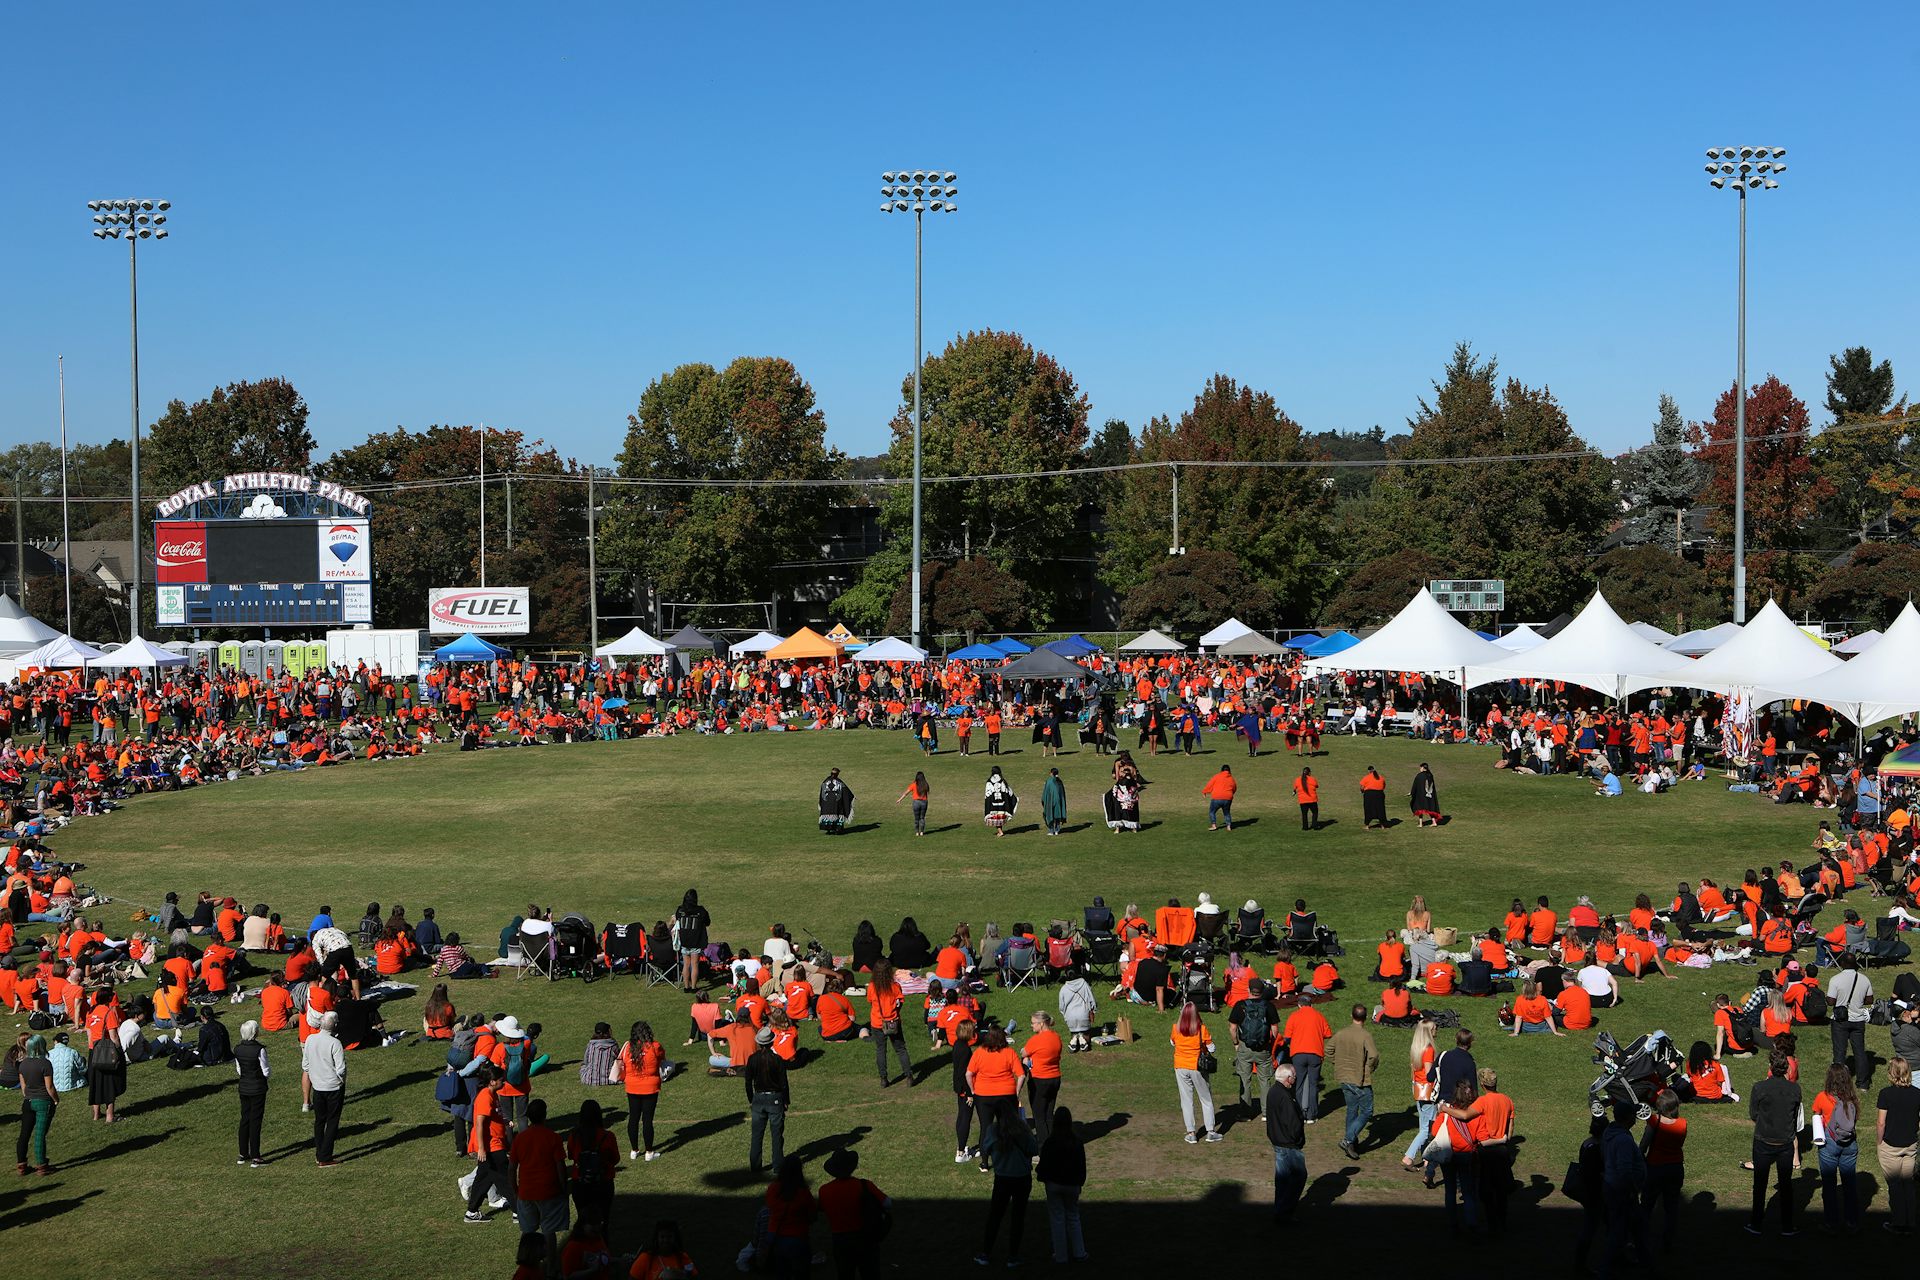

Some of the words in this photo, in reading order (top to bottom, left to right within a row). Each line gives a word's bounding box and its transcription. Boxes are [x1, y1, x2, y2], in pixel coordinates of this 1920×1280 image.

[157, 481, 217, 518] ROYAL
[222, 472, 311, 492] ATHLETIC
[317, 480, 371, 516] PARK
[450, 599, 522, 616] FUEL
